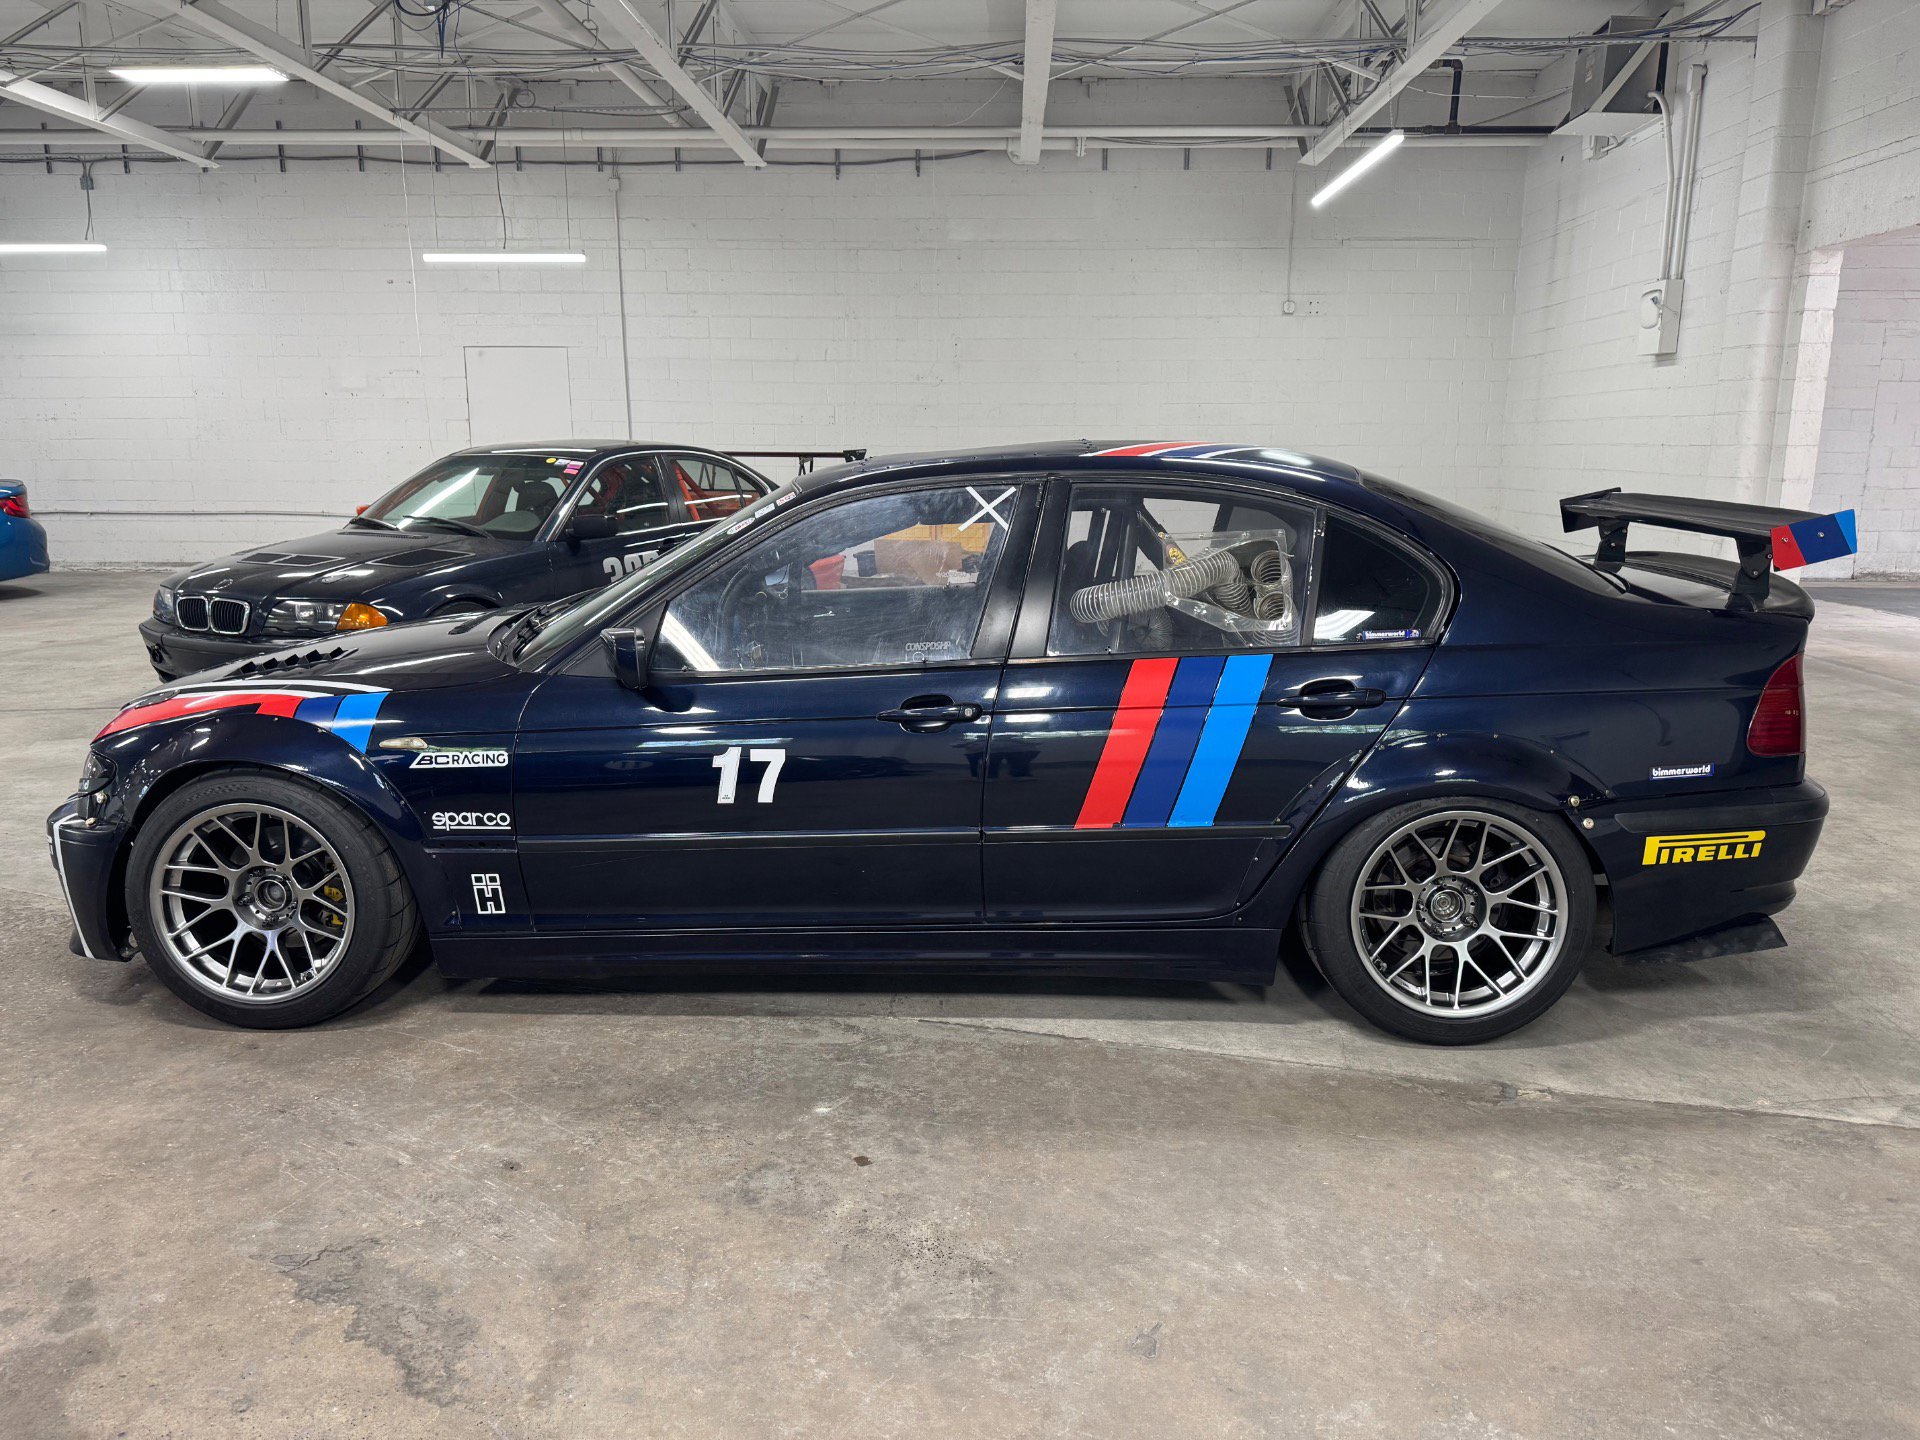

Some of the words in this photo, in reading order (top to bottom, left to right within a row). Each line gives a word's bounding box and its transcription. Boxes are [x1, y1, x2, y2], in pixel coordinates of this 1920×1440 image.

[712, 746, 786, 804] 17
[1652, 764, 1711, 778] bimmerworld
[432, 811, 511, 831] sparco
[1642, 830, 1766, 865] PIRELLI
